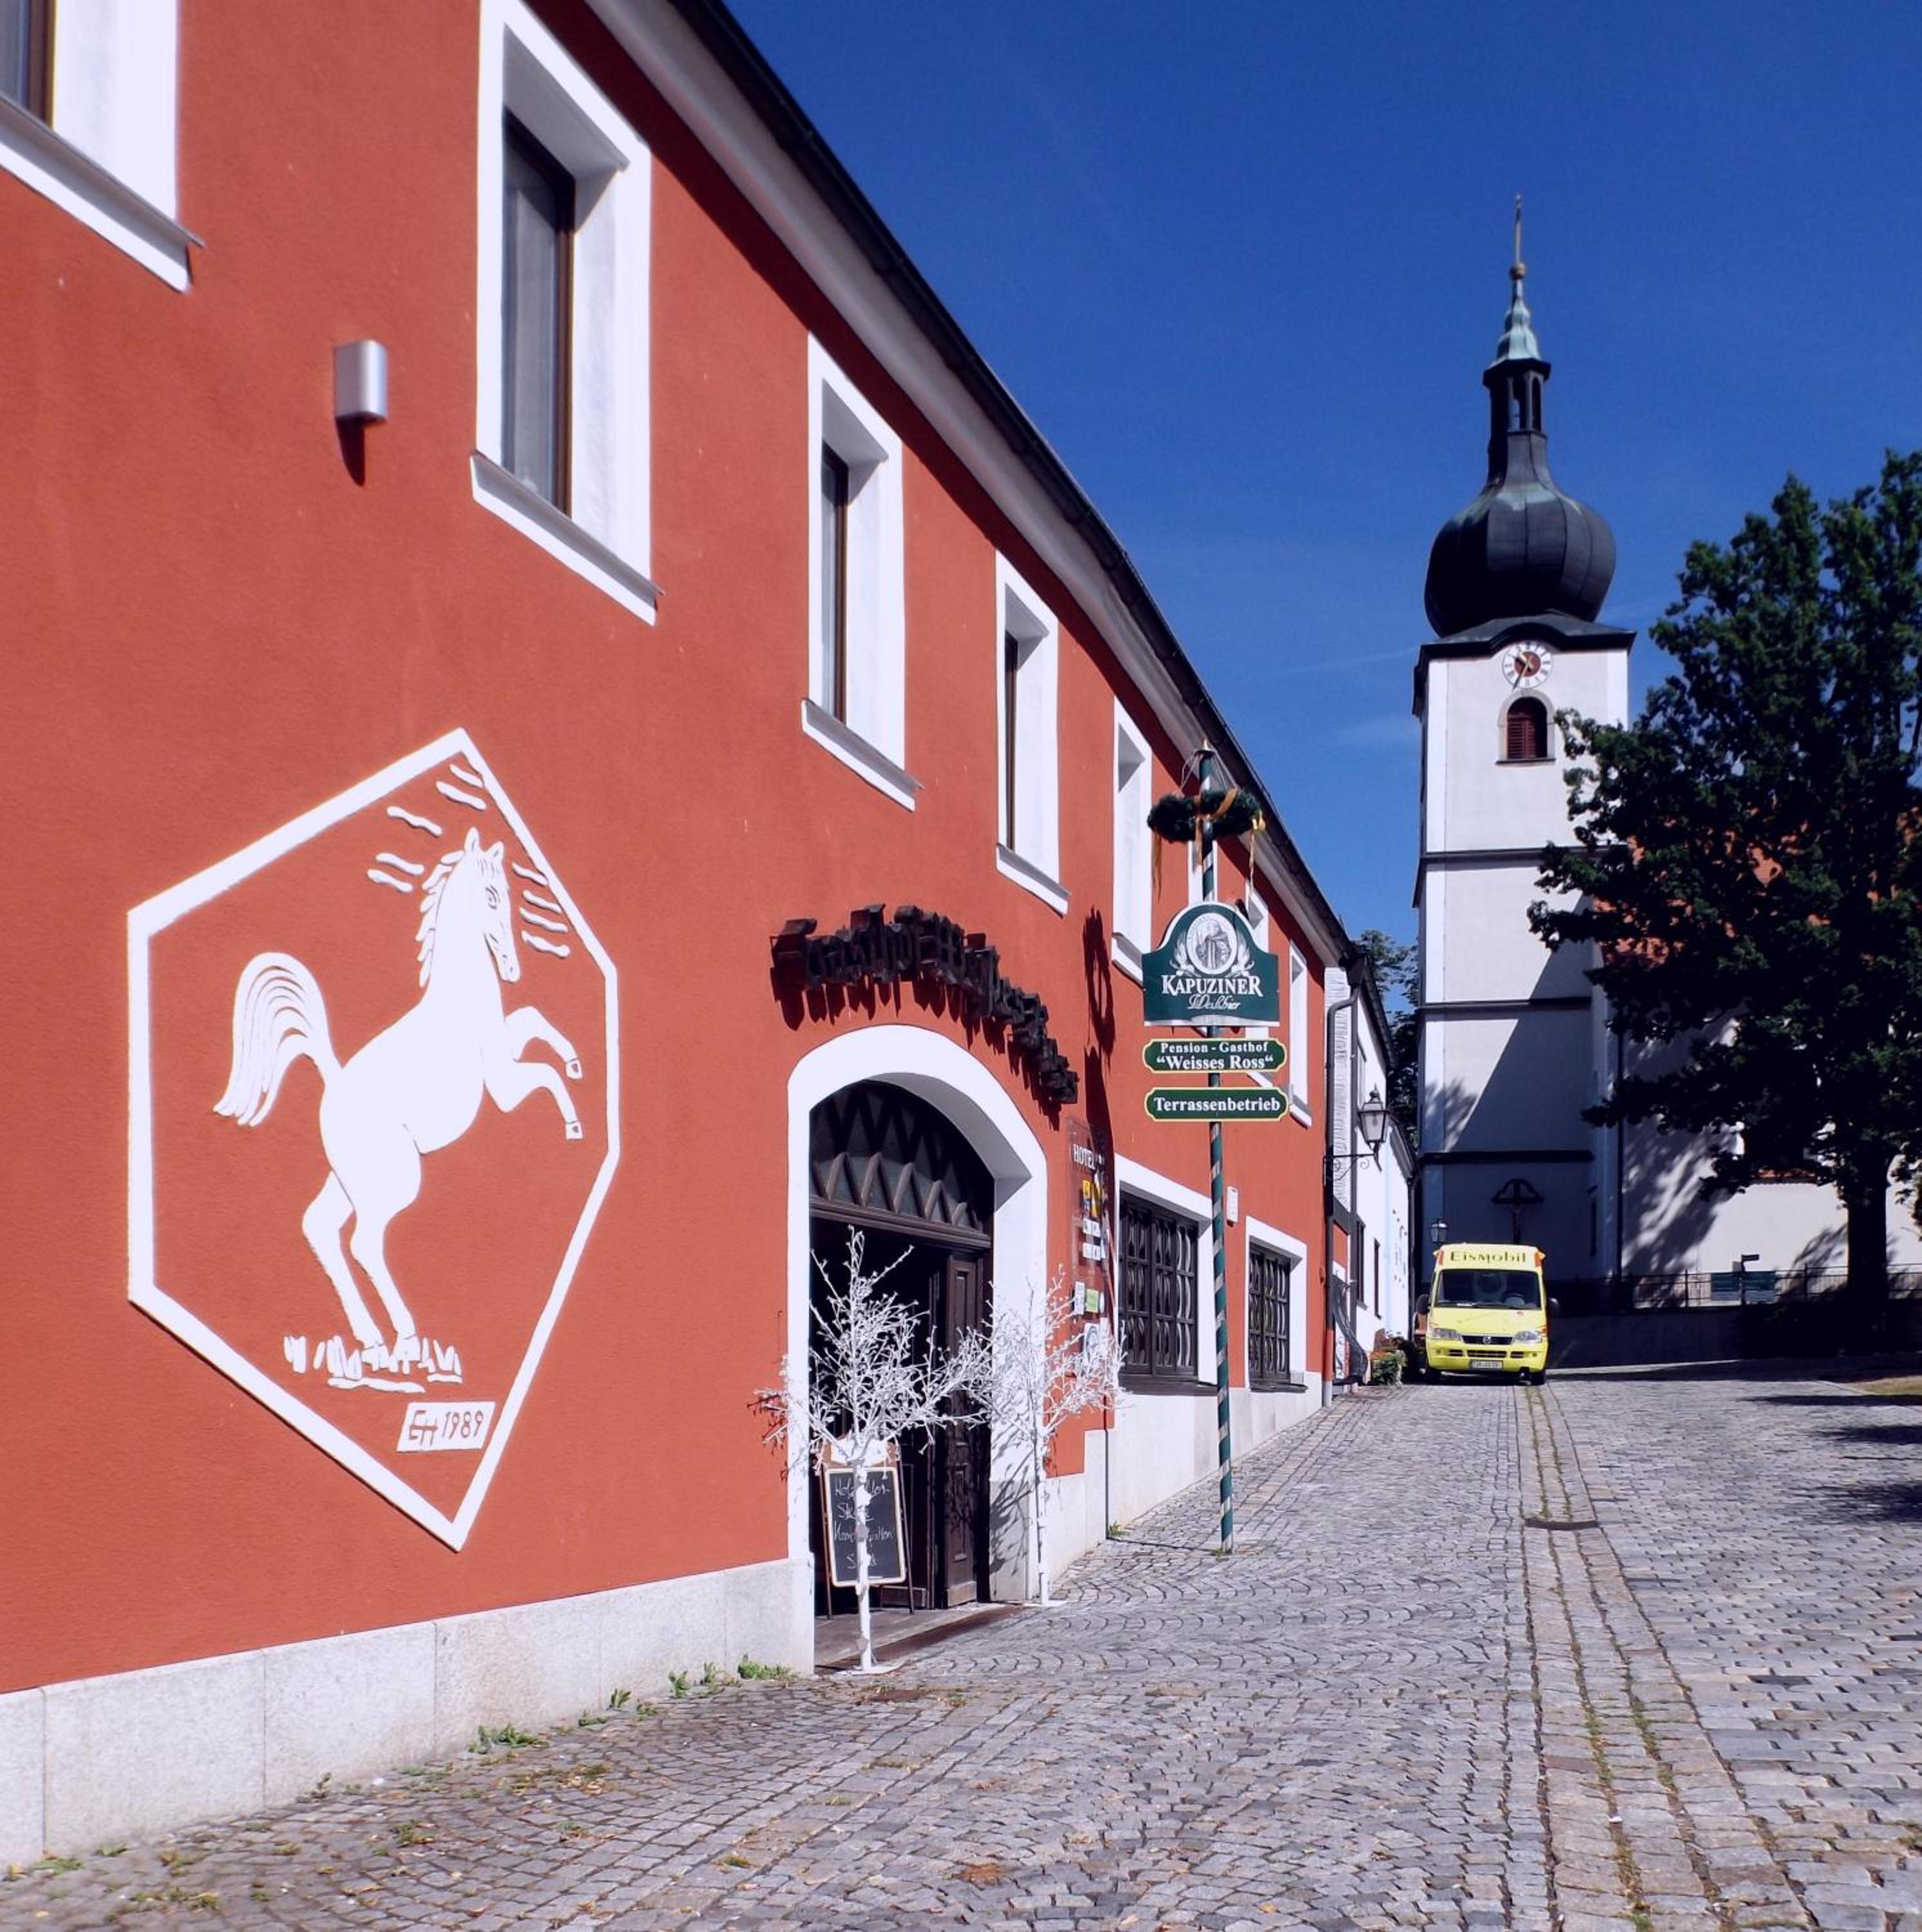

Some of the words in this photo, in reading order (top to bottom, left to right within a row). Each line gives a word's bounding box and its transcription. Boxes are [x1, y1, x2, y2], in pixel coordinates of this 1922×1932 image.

[1161, 974, 1262, 997] KAPUZINER
[1161, 1043, 1208, 1053] Pension
[1219, 1041, 1268, 1053] Gasthof
[1154, 1097, 1281, 1112] Terrassenbetrieb
[441, 1409, 484, 1440] 1989
